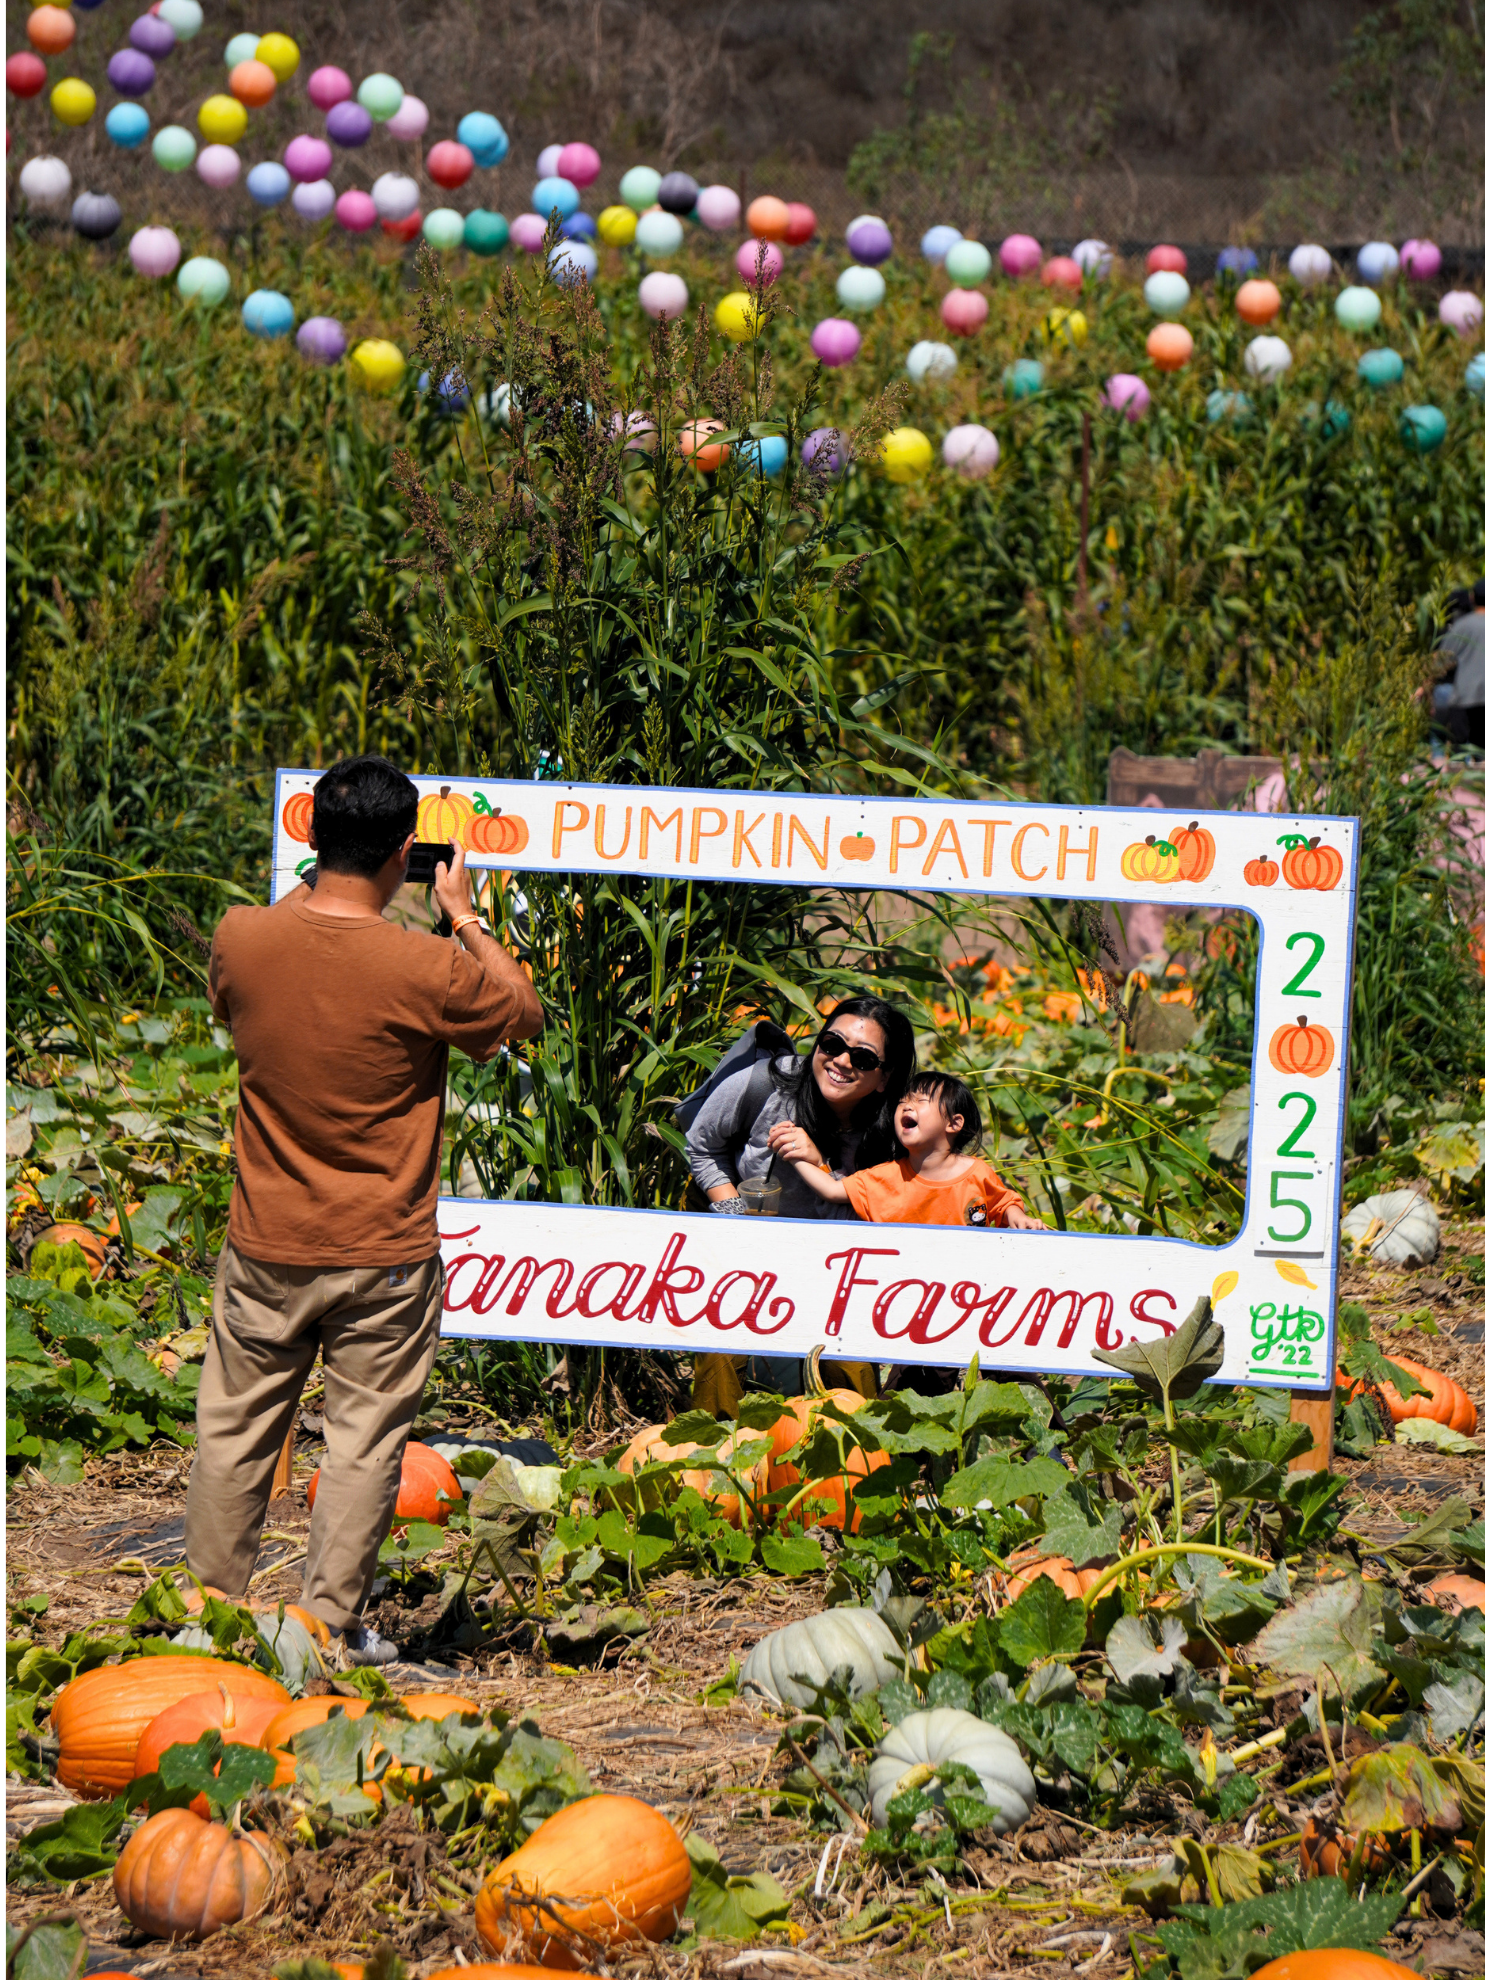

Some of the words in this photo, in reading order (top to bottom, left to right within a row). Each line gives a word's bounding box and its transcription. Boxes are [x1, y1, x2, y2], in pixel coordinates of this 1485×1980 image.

[551, 800, 831, 871] PUMPKIN
[889, 815, 1099, 882] PATCH
[824, 1247, 1178, 1352] Farms
